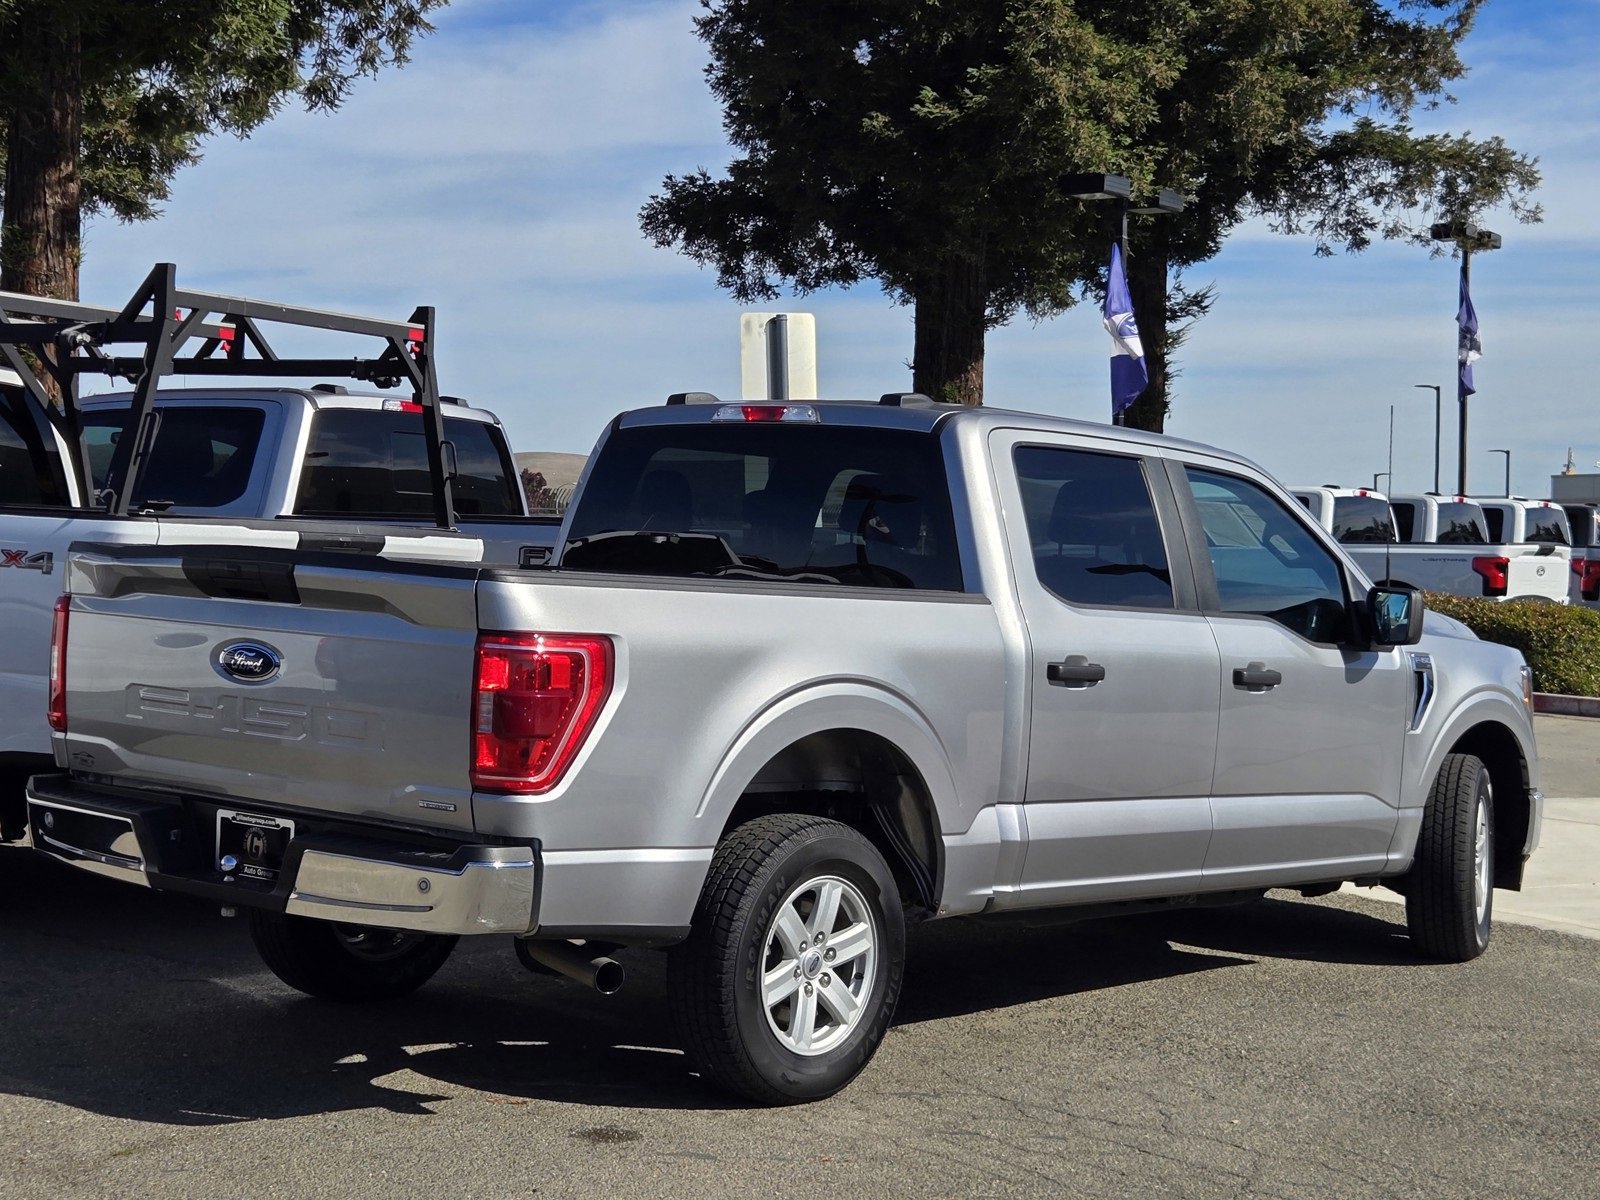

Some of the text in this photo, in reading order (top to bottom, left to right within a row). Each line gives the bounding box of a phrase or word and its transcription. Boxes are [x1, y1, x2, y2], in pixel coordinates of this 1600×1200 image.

[231, 650, 264, 672] Ford
[125, 683, 386, 750] F-150
[243, 866, 256, 875] Auto
[745, 876, 786, 989] IRONMAN
